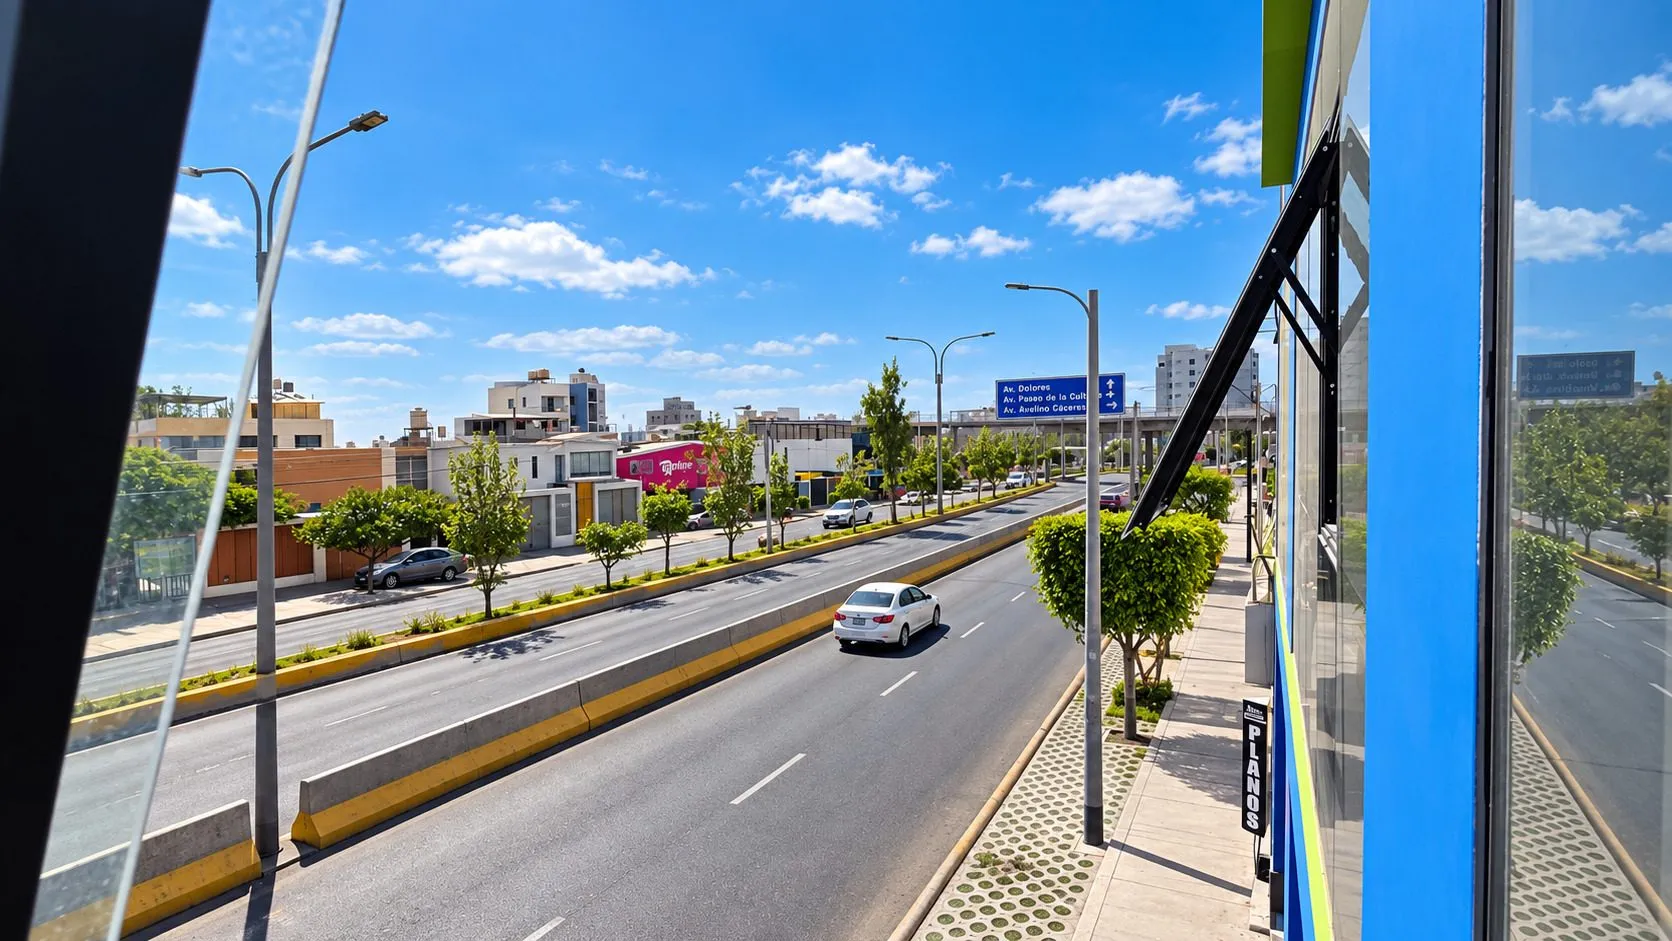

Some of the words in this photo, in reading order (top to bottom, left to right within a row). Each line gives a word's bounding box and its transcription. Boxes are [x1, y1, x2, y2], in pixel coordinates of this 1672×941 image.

[1018, 384, 1051, 393] Dolores
[1003, 406, 1016, 414] Av.
[1246, 724, 1260, 829] PLANOS
